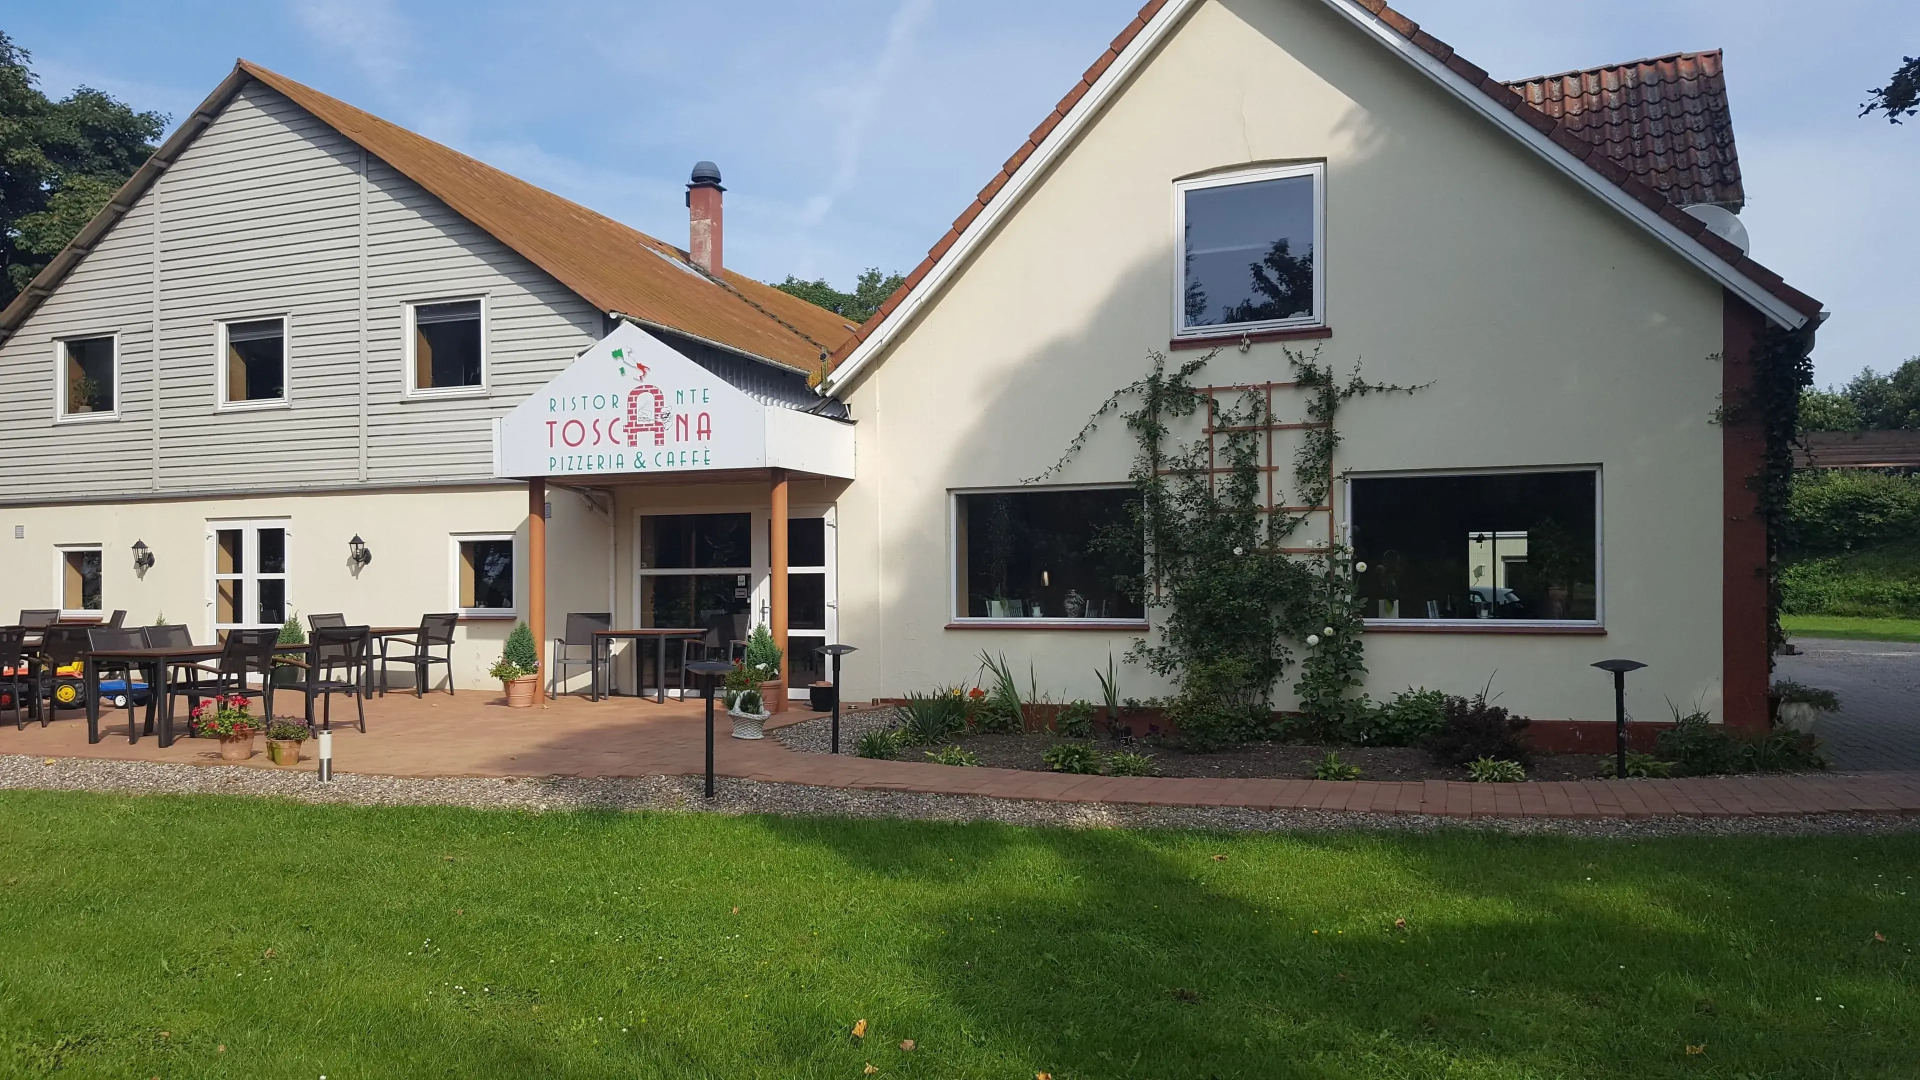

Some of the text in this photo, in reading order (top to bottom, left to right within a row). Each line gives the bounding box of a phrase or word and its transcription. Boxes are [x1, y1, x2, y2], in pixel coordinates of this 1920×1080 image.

[546, 385, 711, 447] TOSCANA
[550, 446, 711, 471] PIZZERIA & CAFFÈ
